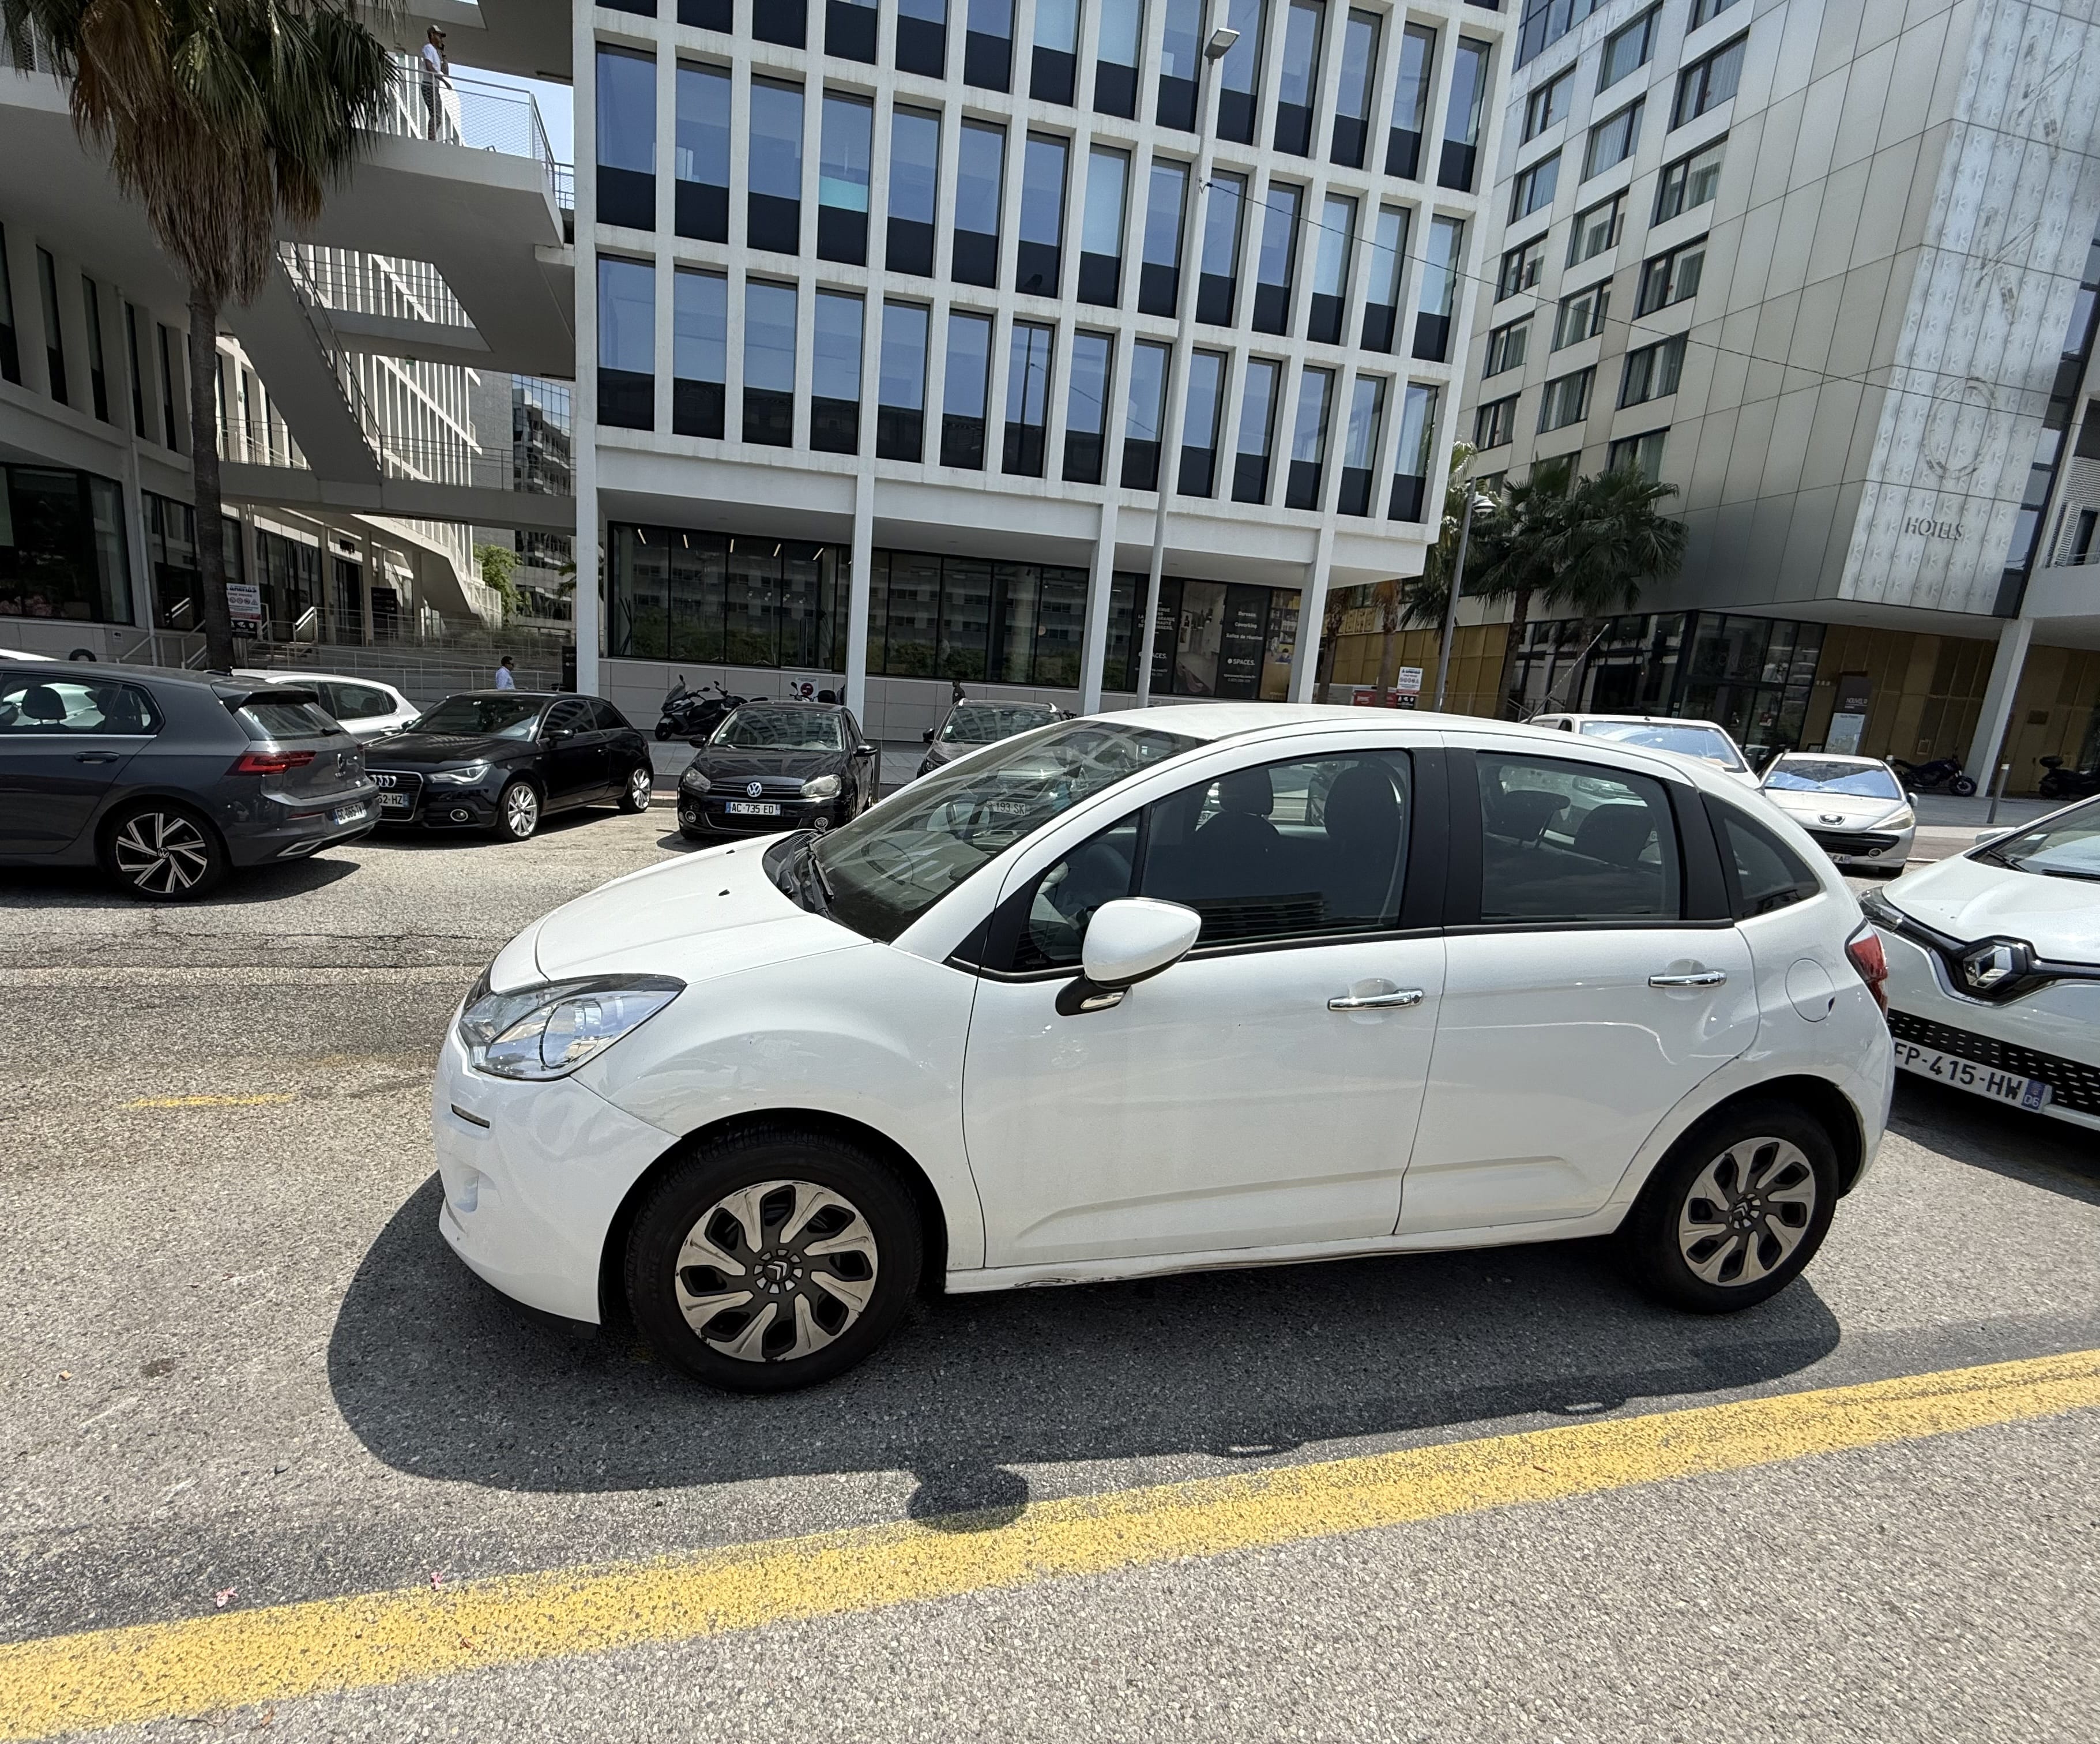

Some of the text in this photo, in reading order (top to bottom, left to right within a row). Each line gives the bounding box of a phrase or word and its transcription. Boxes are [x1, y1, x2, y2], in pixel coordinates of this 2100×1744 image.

[1905, 517, 1964, 540] HOTELS
[1894, 1042, 2039, 1107] FP-415-HW 06
